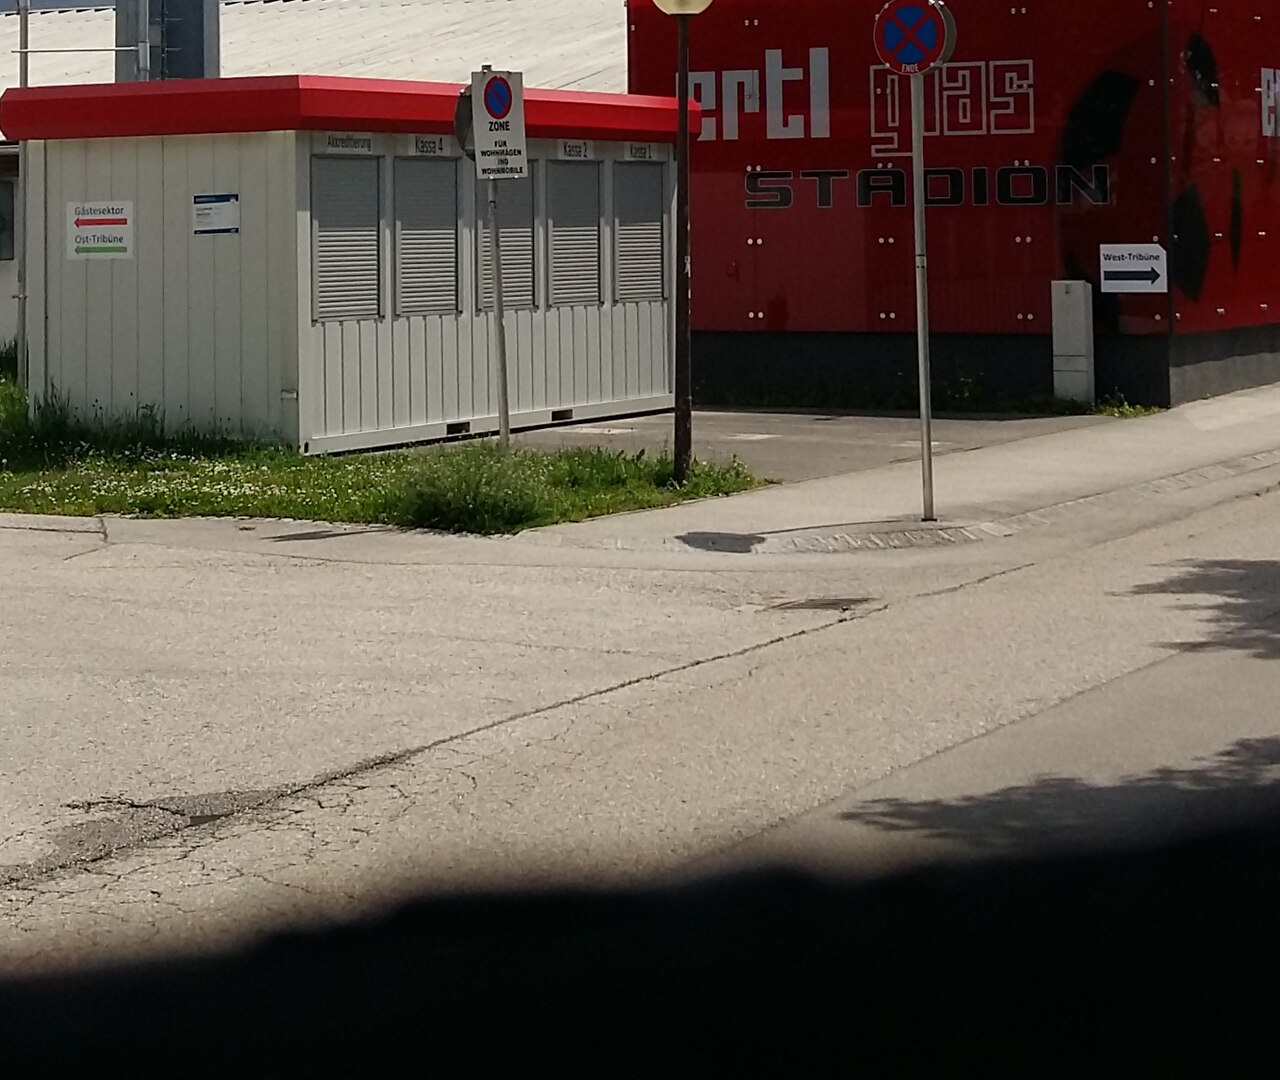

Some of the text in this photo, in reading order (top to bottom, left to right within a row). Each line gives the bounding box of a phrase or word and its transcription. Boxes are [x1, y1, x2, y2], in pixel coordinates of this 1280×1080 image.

[901, 63, 920, 73] ENDE
[488, 121, 511, 132] ZONE
[415, 135, 437, 154] Kassa
[494, 139, 507, 148] FÜR
[563, 141, 582, 158] Kassa
[630, 143, 647, 159] Kassa
[745, 164, 1110, 209] STADION
[74, 206, 124, 216] Gästesektor
[74, 235, 124, 244] Ost-Tribüne
[1103, 251, 1160, 261] West-Tribüne
